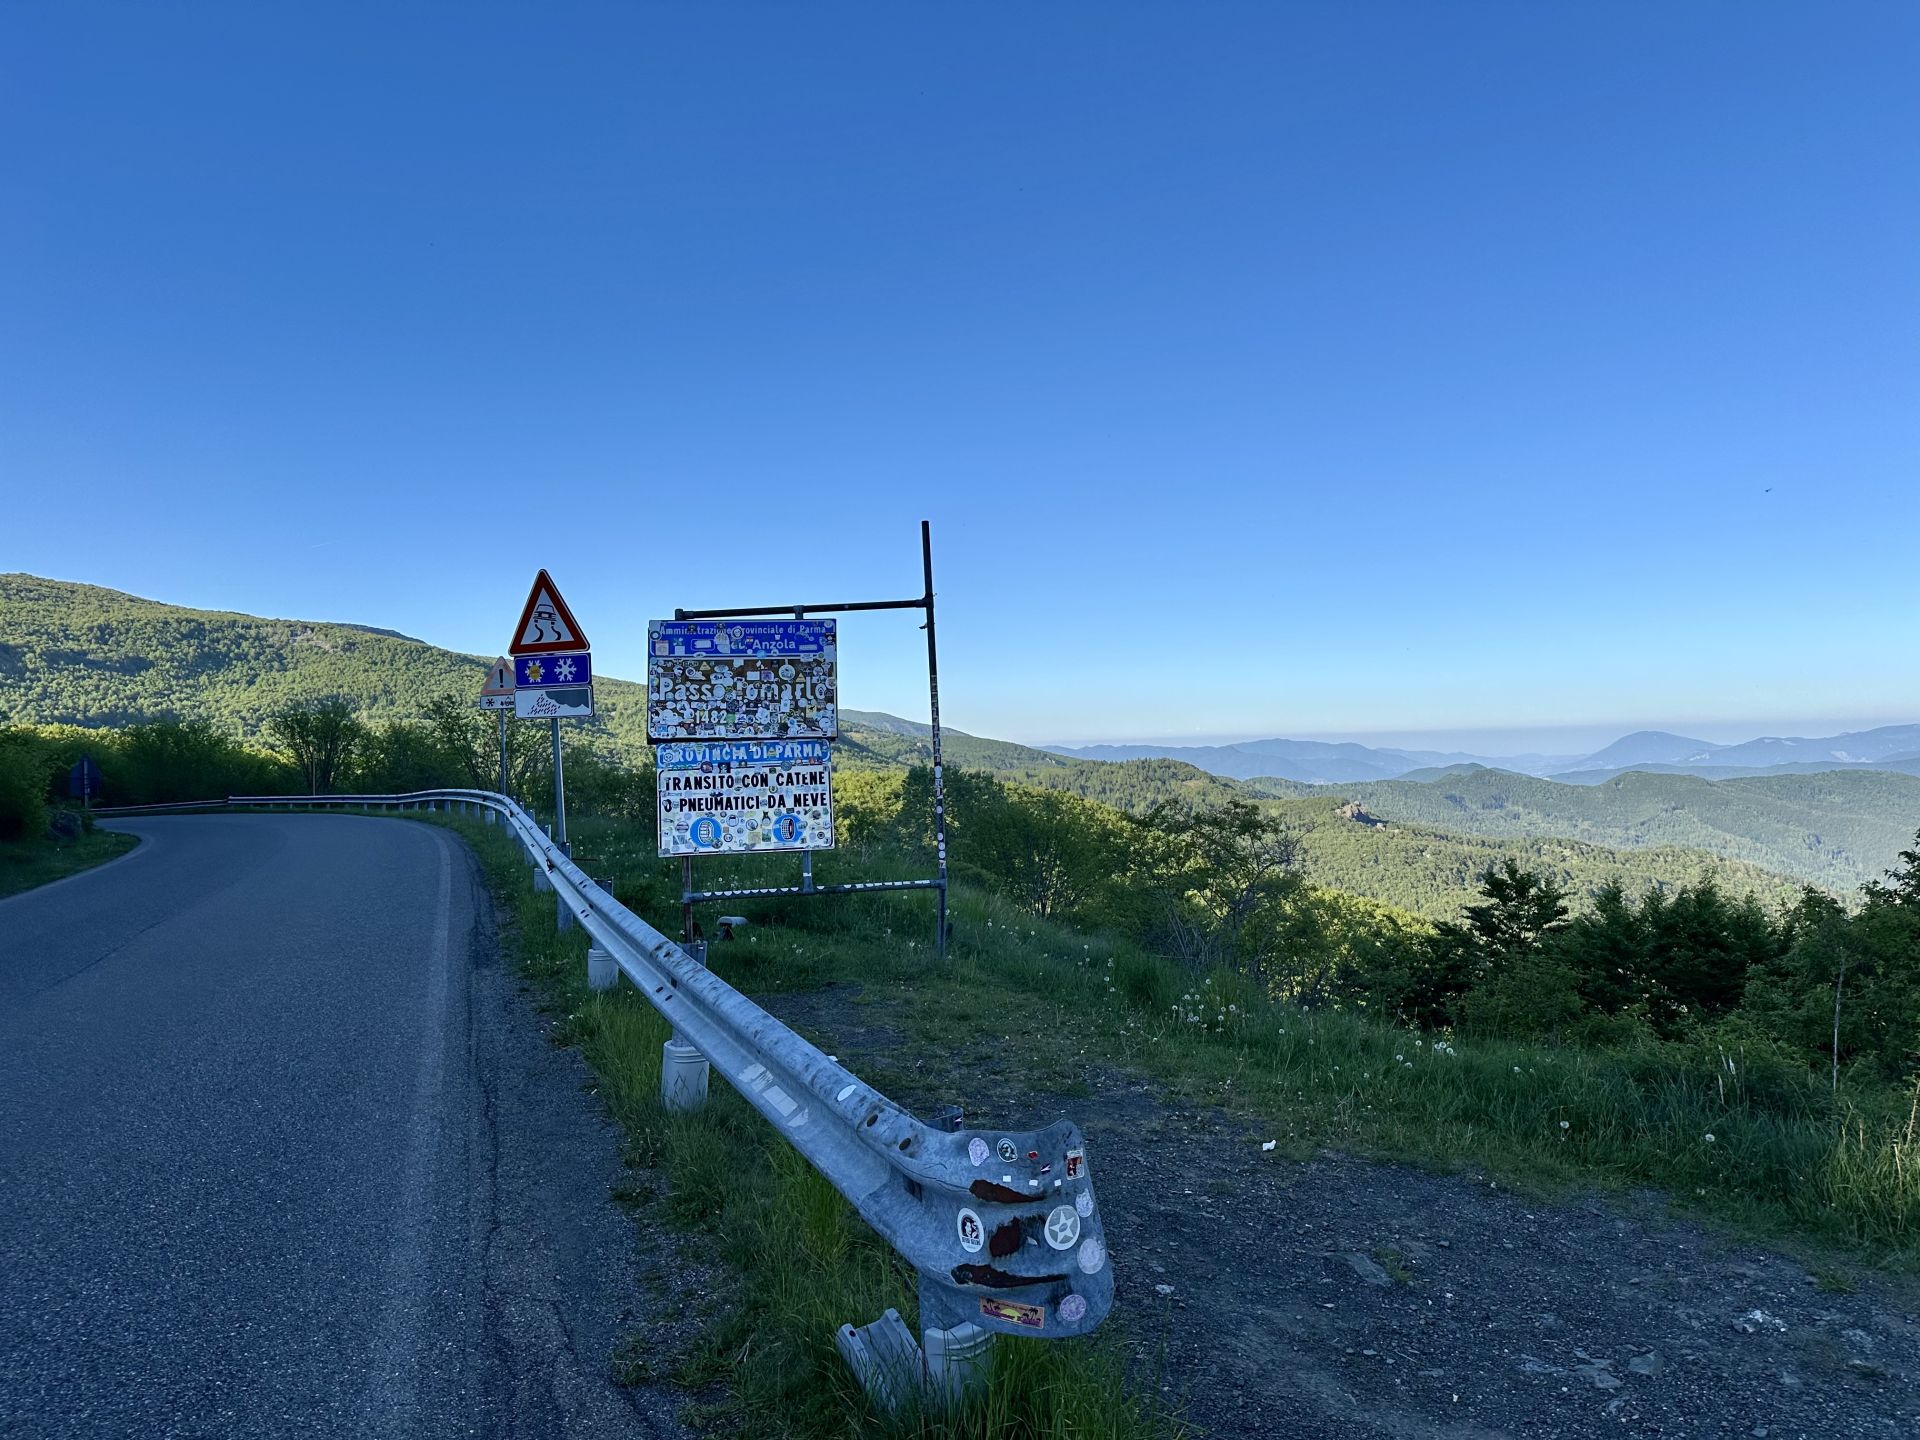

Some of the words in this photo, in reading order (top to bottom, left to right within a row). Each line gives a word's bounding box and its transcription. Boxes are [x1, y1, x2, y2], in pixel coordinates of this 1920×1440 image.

[660, 624, 732, 635] Ammitrazione
[737, 624, 783, 634] rovinciale
[787, 624, 796, 634] di
[799, 624, 826, 634] Parma
[752, 638, 796, 650] Anzola
[660, 677, 726, 701] Passo
[695, 709, 727, 724] 1482
[669, 745, 748, 762] ROVINCIA
[752, 745, 768, 760] DI
[775, 743, 823, 759] PARMA
[665, 775, 735, 791] TRANSITO
[741, 773, 769, 788] CON
[775, 771, 826, 787] CATENE
[679, 795, 760, 813] PNEUMATICI
[767, 793, 787, 809] DA
[793, 792, 828, 808] NEVE
